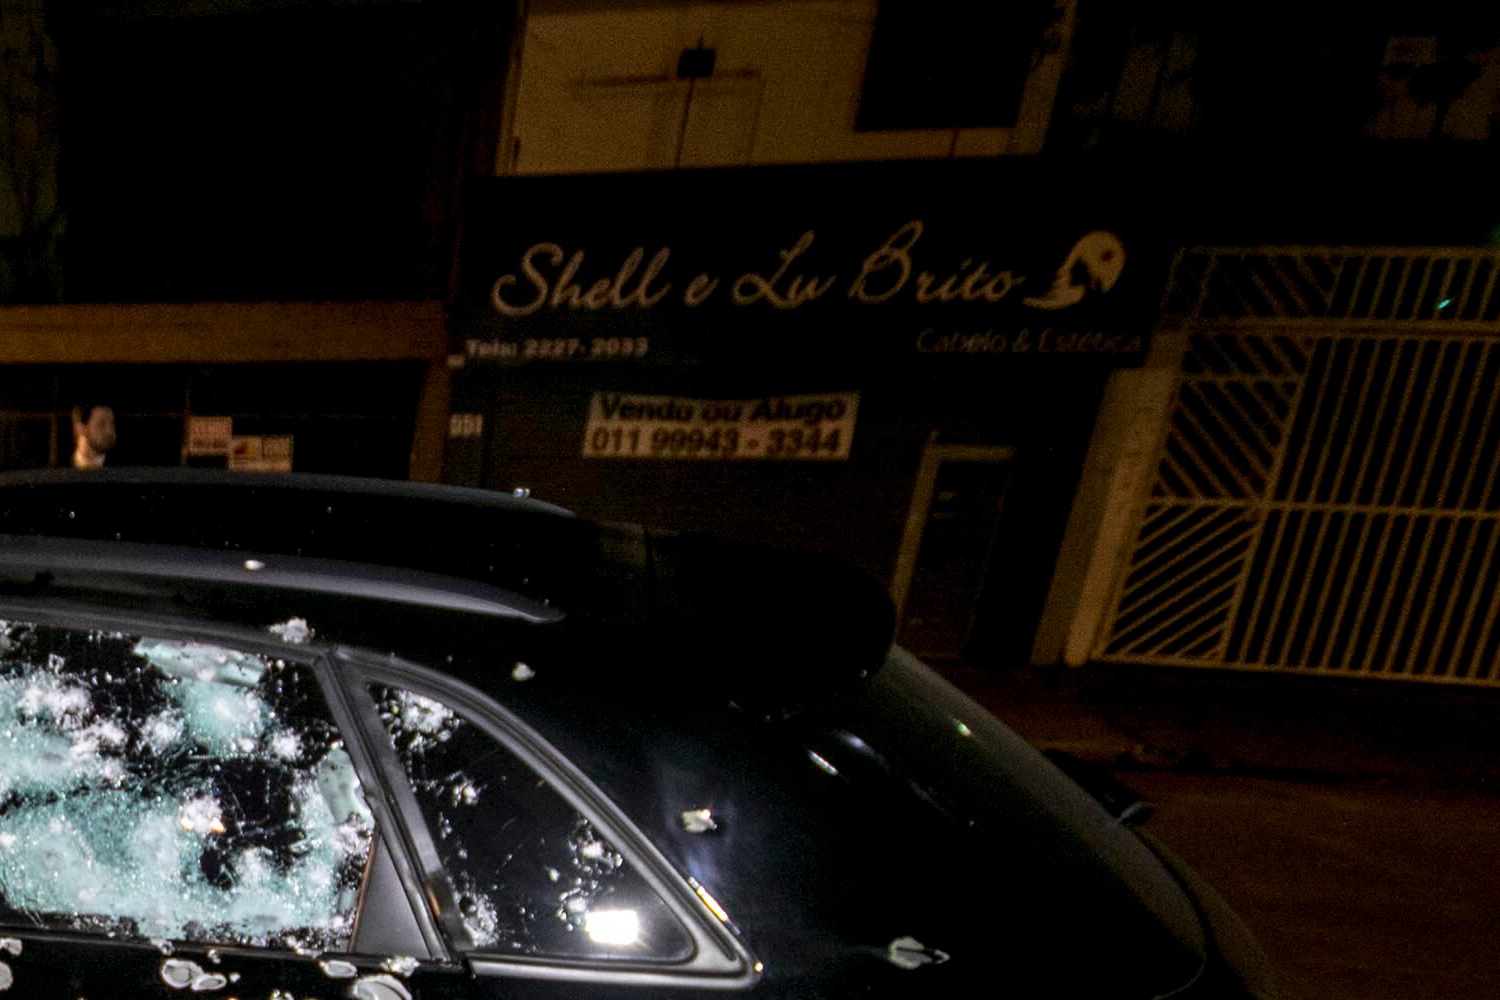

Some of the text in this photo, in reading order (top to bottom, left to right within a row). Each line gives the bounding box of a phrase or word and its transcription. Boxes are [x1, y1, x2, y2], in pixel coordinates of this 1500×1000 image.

[490, 217, 1028, 318] Shell e Lu Brito
[601, 396, 846, 425] Vendo ou Alugo
[591, 426, 642, 452] 011
